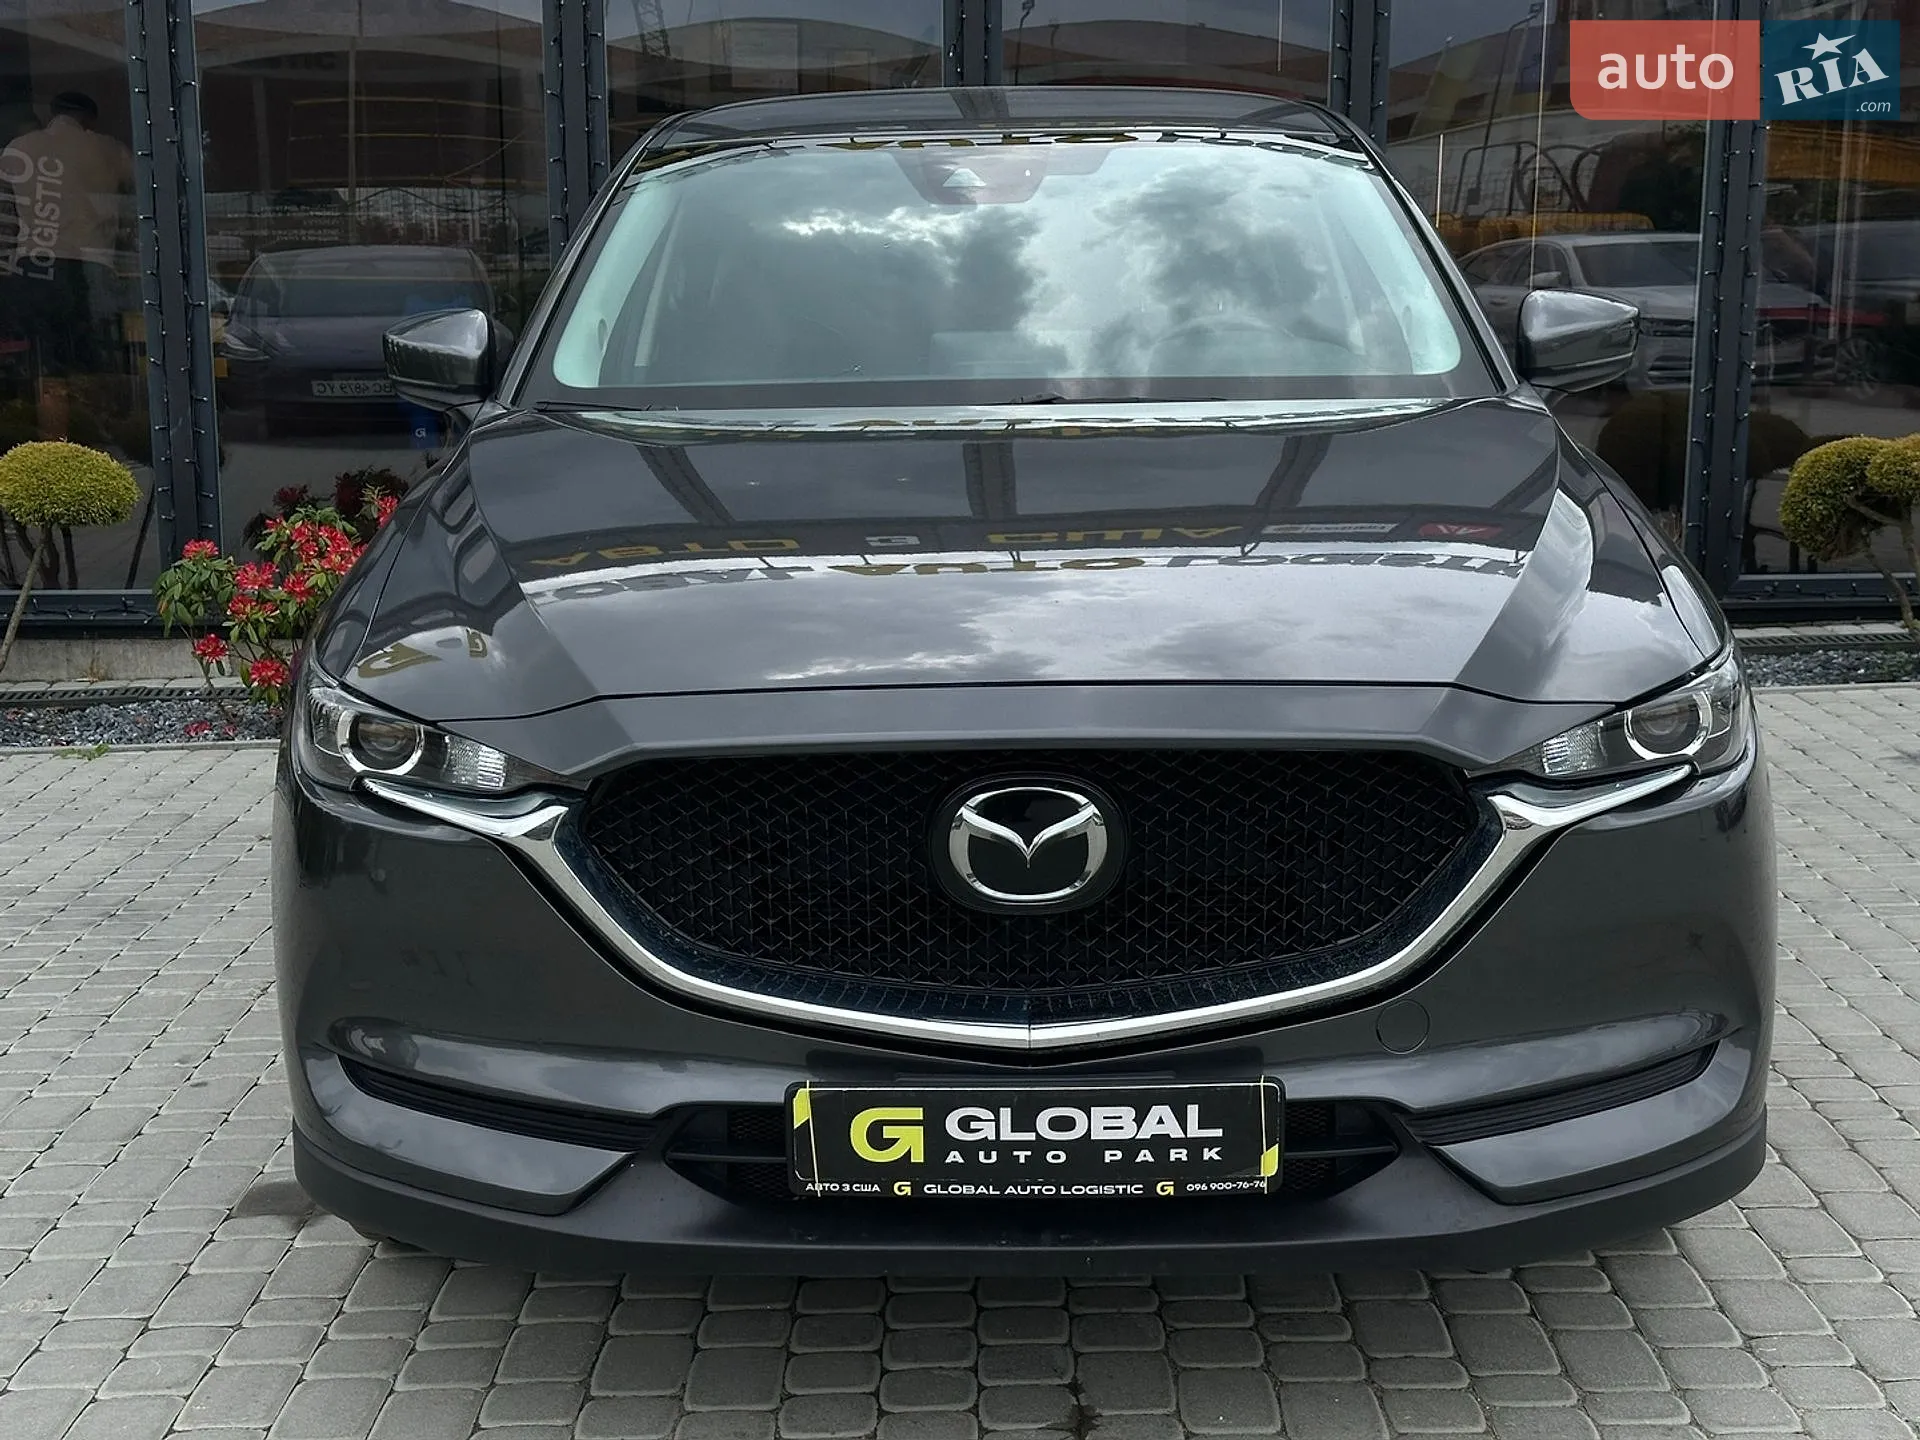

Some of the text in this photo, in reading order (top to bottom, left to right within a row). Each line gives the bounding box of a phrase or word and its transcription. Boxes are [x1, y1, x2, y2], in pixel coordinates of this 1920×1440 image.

[27, 155, 64, 281] LOGISTIC
[945, 1104, 1223, 1142] GLOBAL
[944, 1147, 1223, 1164] AUTO PARK
[805, 1182, 840, 1193] АВТО
[852, 1182, 881, 1193] США
[923, 1184, 1000, 1195] GLOBAL
[1004, 1184, 1056, 1195] AUTO
[1060, 1183, 1145, 1195] LOGISTIC
[1186, 1183, 1208, 1192] 096
